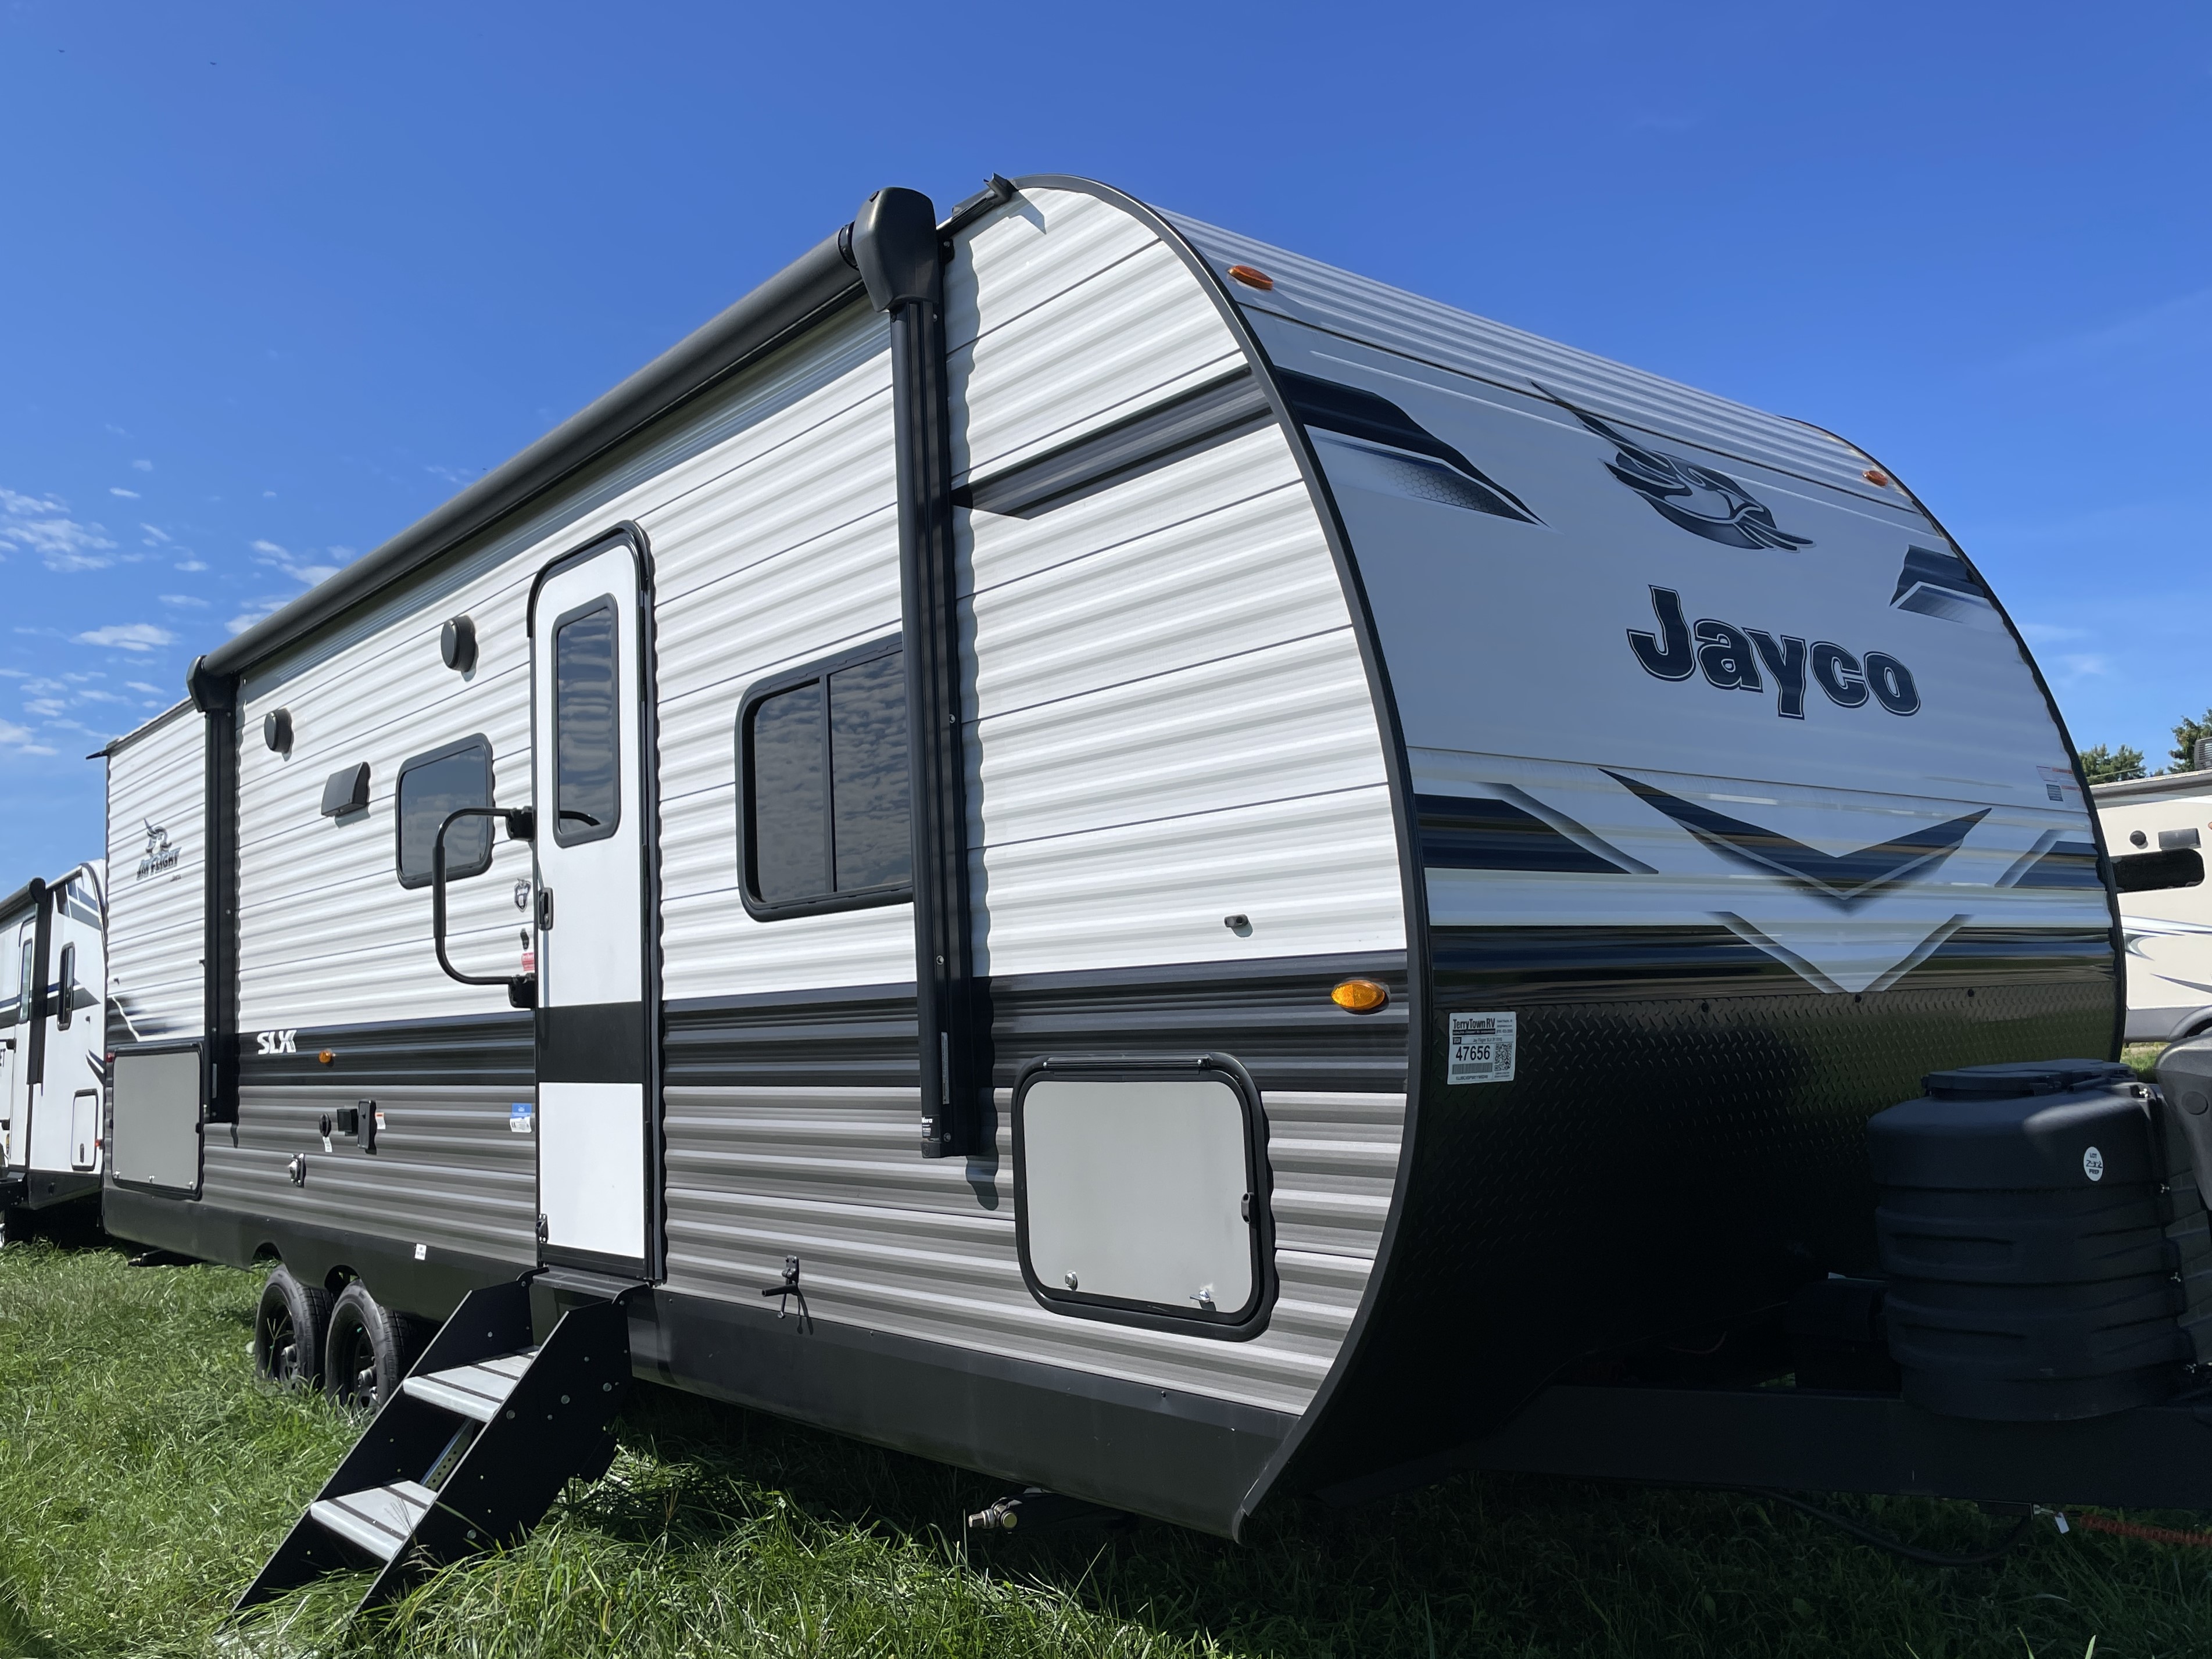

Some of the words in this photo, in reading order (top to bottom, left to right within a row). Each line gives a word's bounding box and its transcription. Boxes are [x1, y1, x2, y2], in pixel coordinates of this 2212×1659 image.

[1626, 584, 1921, 721] Jayco
[1453, 1019, 1486, 1030] TerryTown
[1486, 1017, 1495, 1028] RV
[257, 1030, 297, 1055] SLX
[1455, 1045, 1490, 1061] 47656
